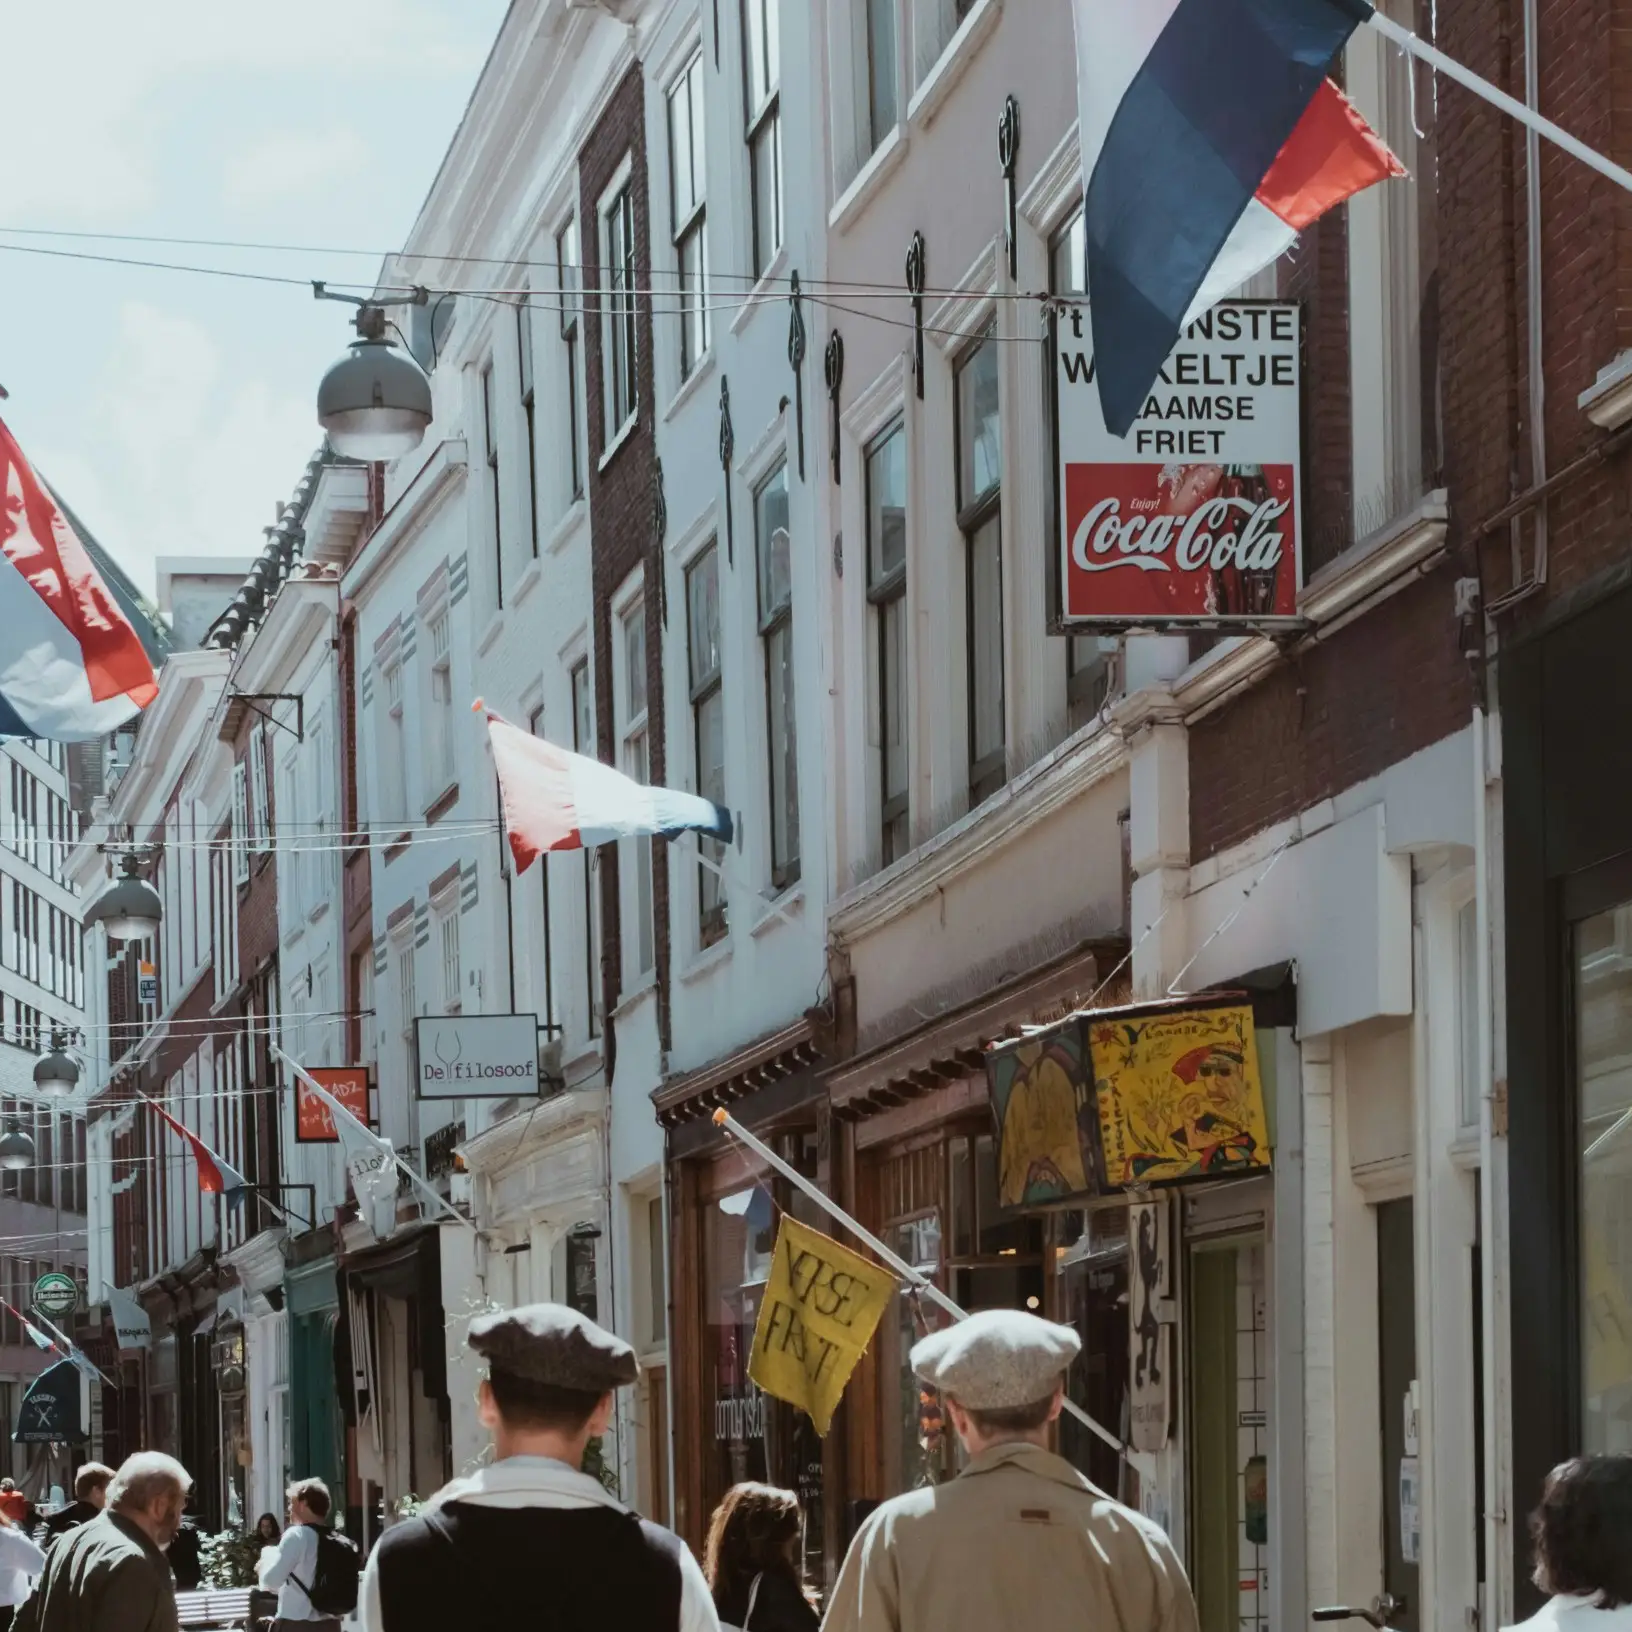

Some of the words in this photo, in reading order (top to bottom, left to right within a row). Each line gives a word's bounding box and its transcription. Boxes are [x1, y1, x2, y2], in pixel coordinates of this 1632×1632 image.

[1062, 352, 1295, 386] WELTJE
[1136, 396, 1255, 420] AAMSE
[1136, 431, 1226, 455] FRIET
[1130, 498, 1160, 510] Enjoy!
[1072, 496, 1290, 573] Coca-Cola
[424, 1064, 444, 1080] De
[454, 1060, 533, 1079] filosoof
